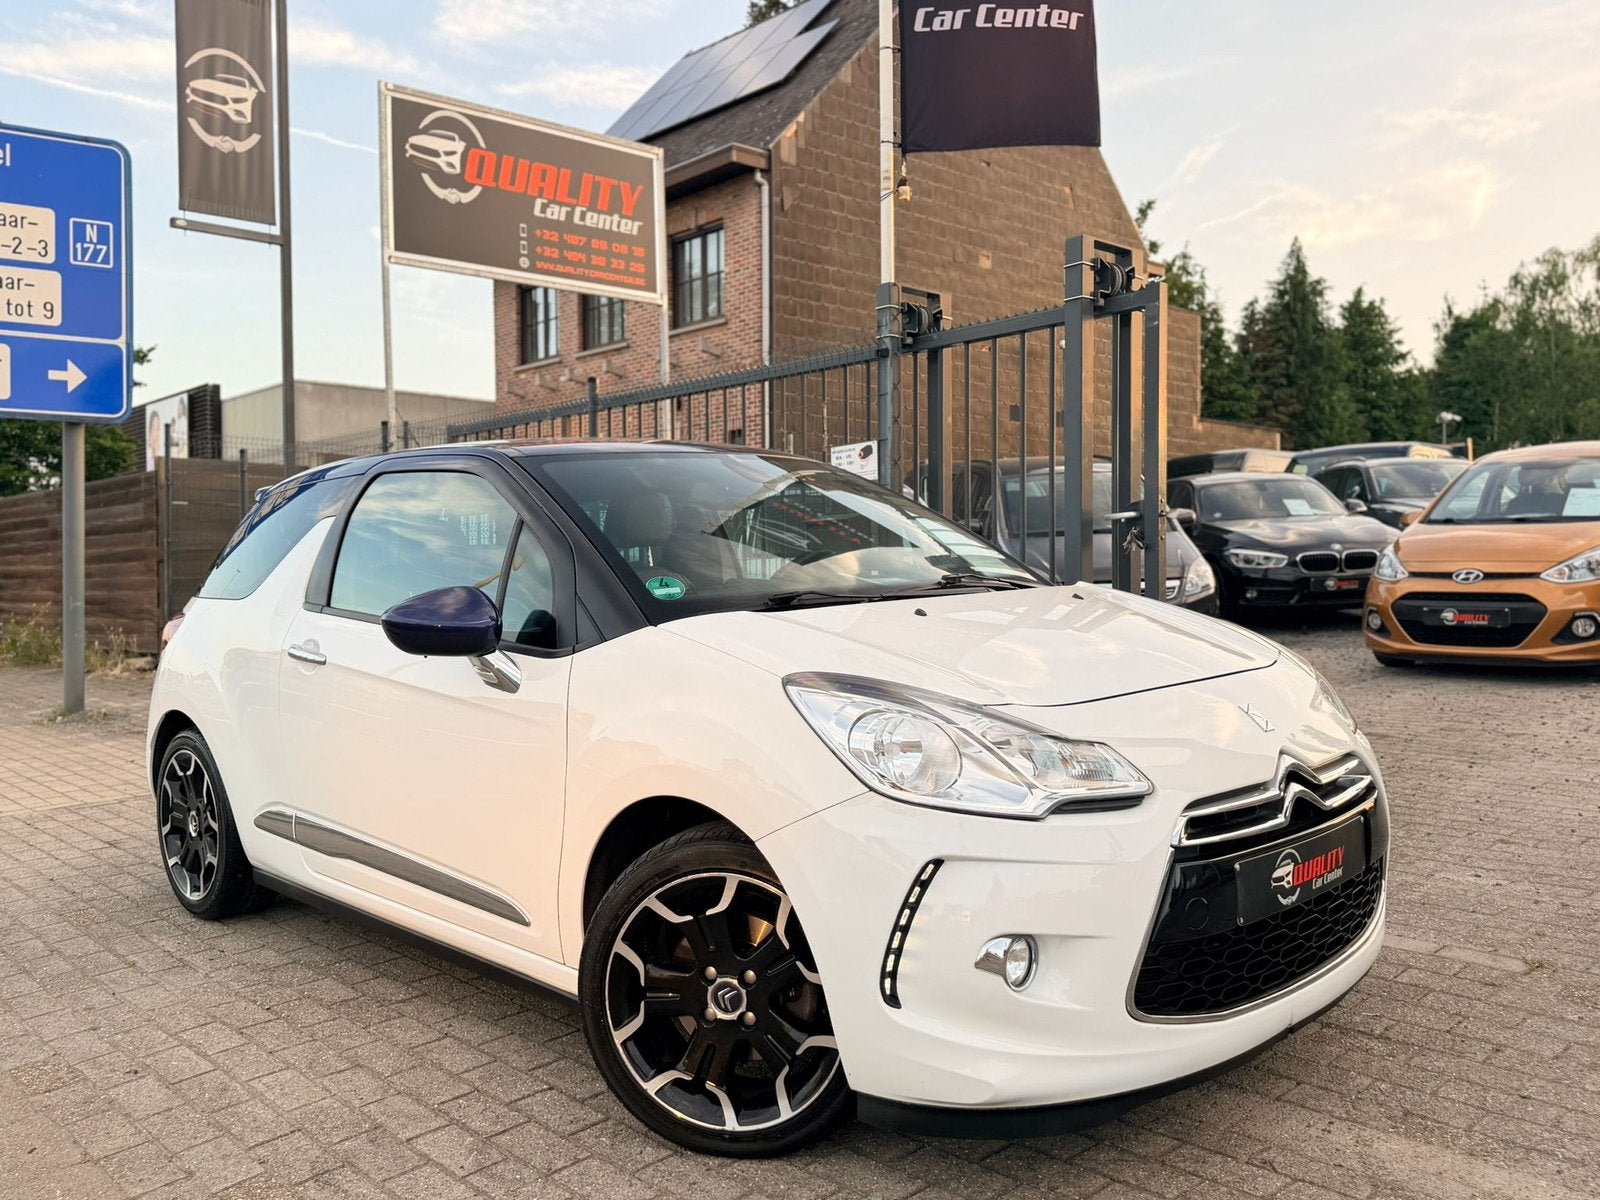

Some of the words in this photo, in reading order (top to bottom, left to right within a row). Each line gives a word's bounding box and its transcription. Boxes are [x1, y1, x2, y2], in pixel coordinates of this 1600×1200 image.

[913, 7, 972, 32] Car
[975, 4, 1084, 31] Center
[464, 147, 644, 217] QUALITY
[533, 198, 572, 222] Car
[573, 206, 644, 236] Center
[85, 224, 98, 243] N
[535, 228, 560, 243] +32
[75, 242, 108, 264] 177
[535, 245, 560, 259] +32
[0, 275, 35, 291] ar-
[6, 300, 34, 319] tot
[43, 301, 55, 319] 9
[659, 578, 670, 588] 4
[1293, 845, 1344, 887] QUALITY
[1312, 876, 1325, 890] Car
[1323, 866, 1344, 884] Center
